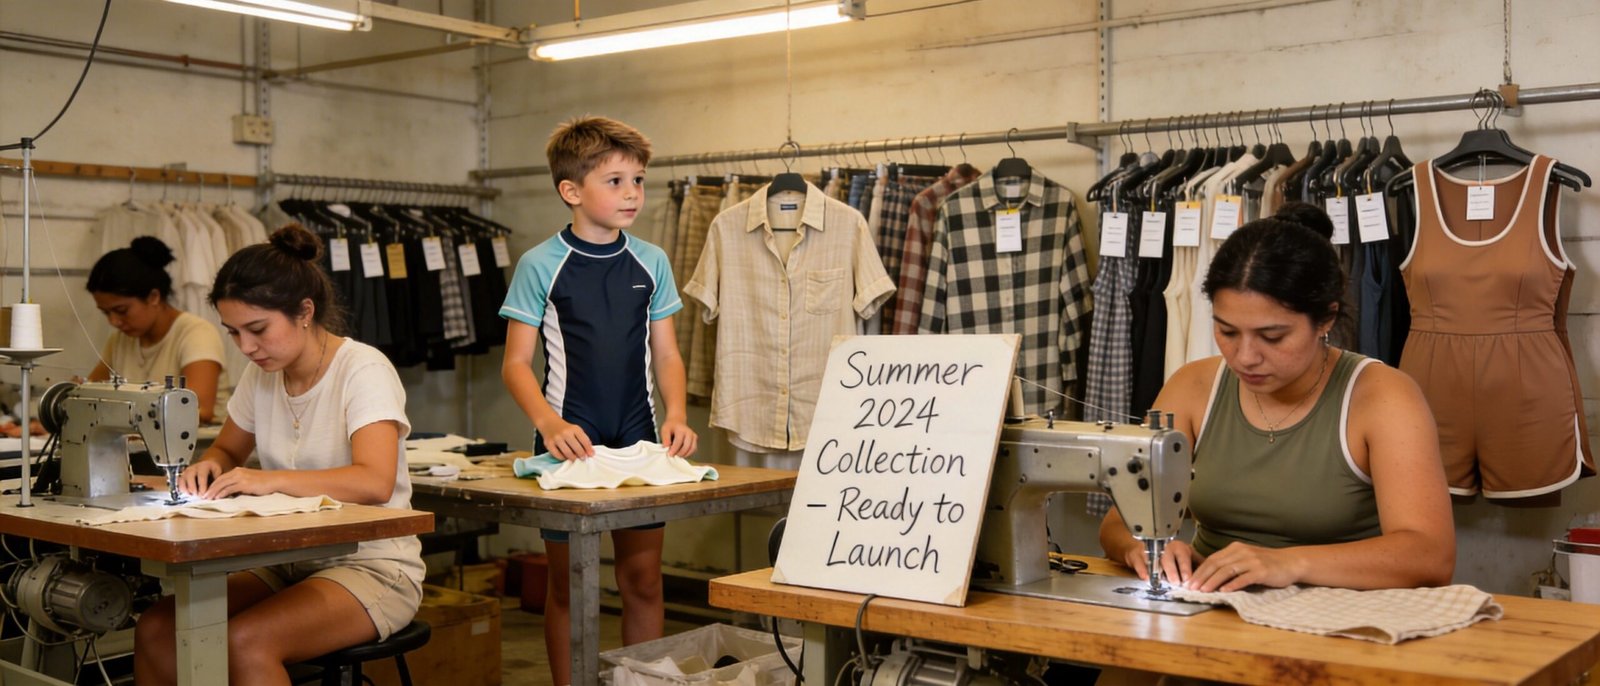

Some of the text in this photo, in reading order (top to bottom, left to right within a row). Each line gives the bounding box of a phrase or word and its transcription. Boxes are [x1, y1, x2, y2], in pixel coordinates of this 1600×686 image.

[840, 350, 983, 389] Summer
[853, 396, 939, 433] 2024
[816, 439, 966, 477] Collection
[837, 486, 924, 536] Ready
[933, 493, 965, 524] to
[826, 530, 940, 574] Launch
